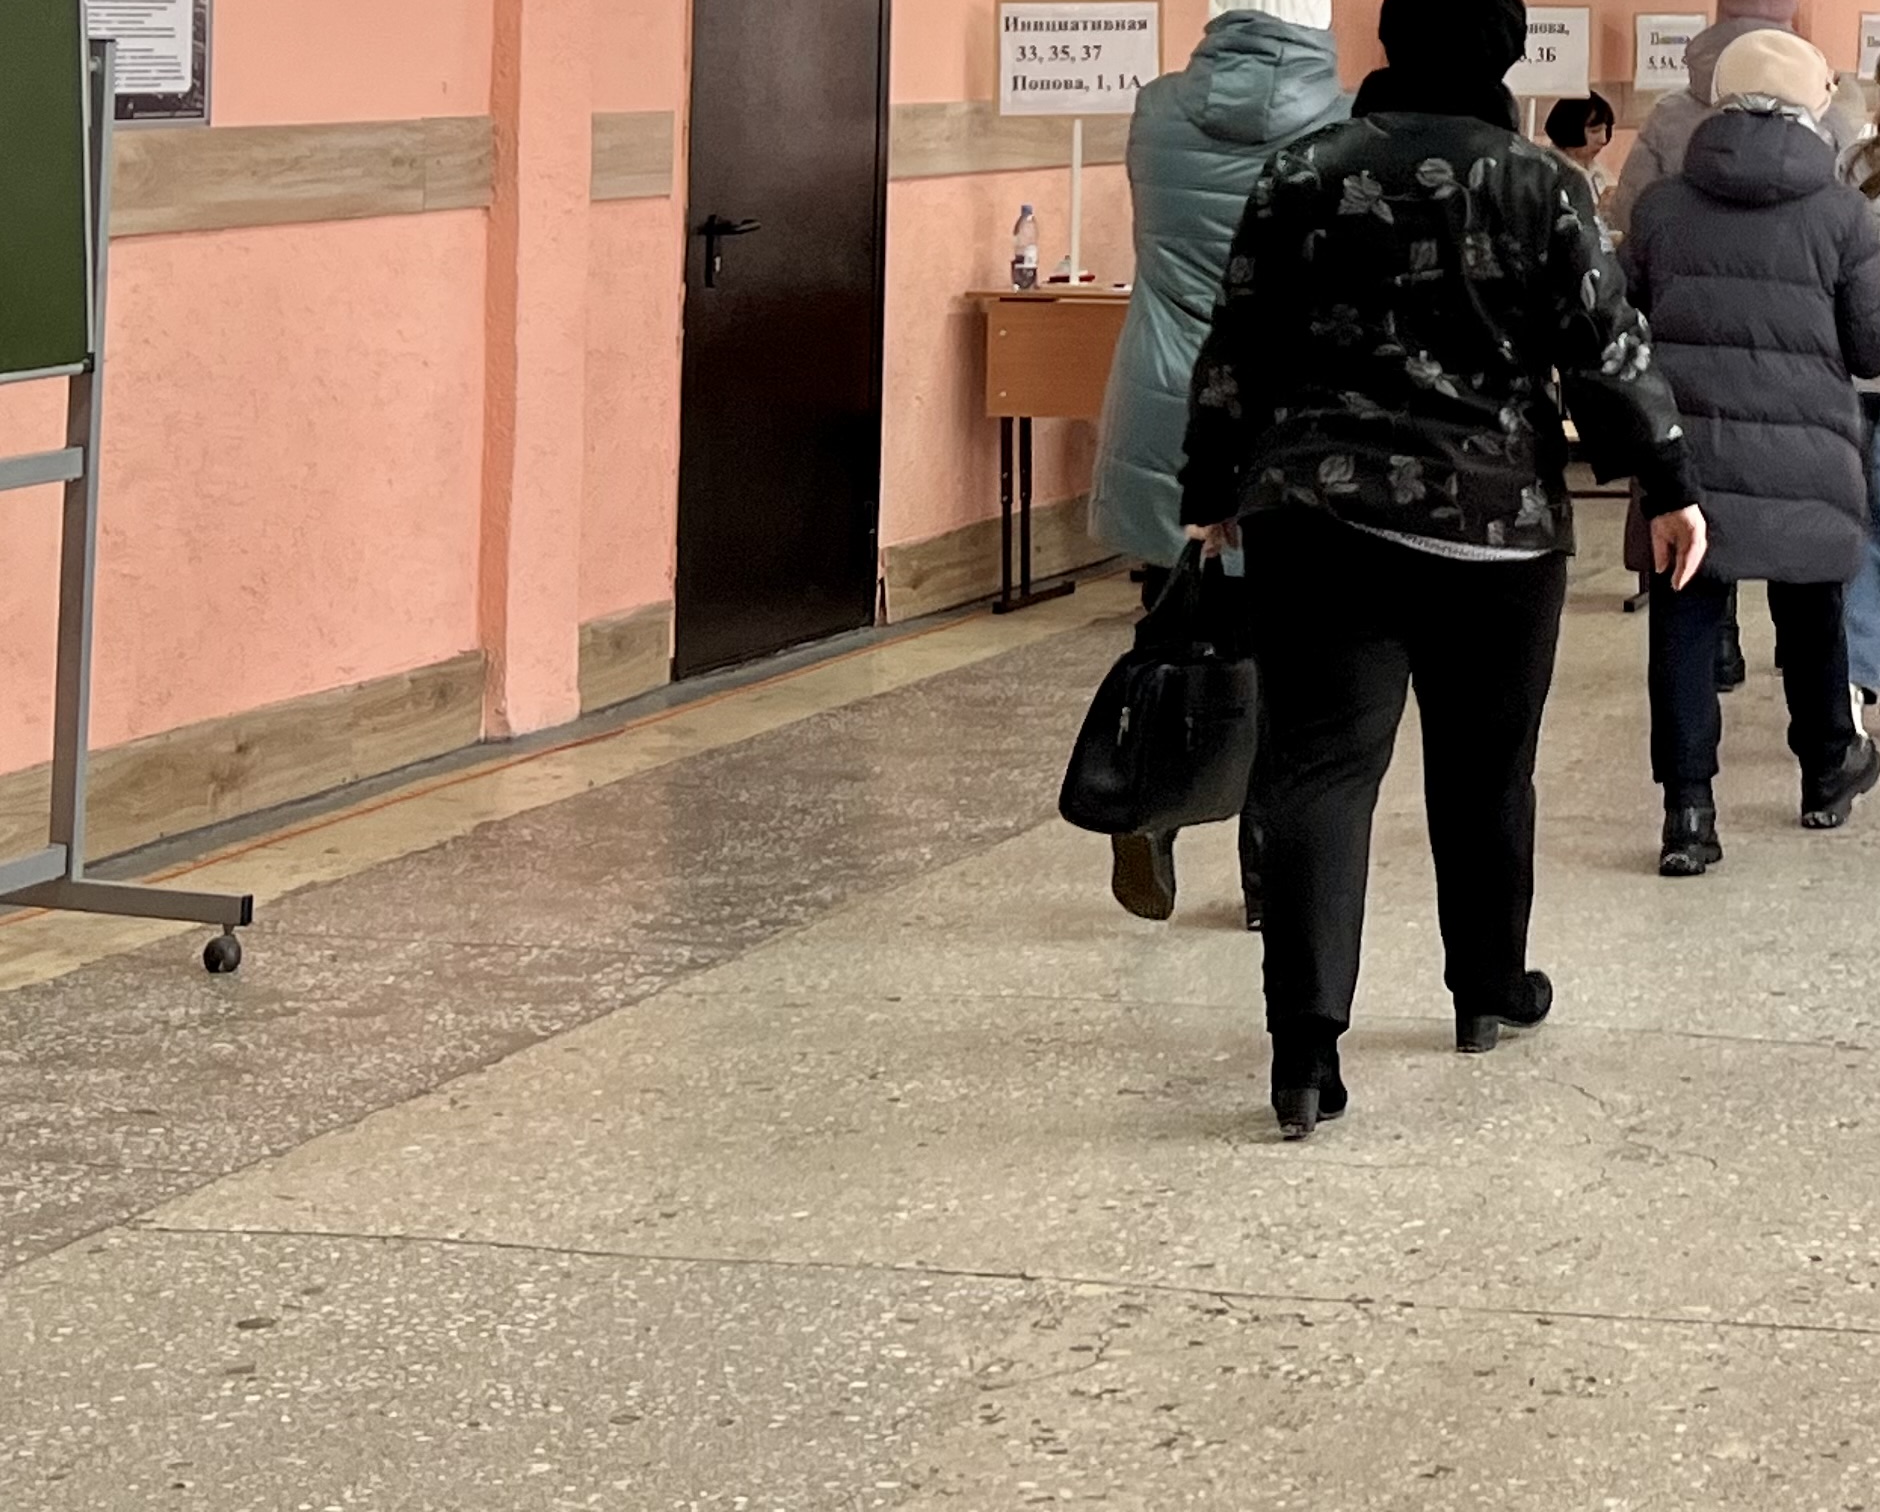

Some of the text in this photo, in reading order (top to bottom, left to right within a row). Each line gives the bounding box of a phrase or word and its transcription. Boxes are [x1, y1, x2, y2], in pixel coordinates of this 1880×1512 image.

[1004, 15, 1148, 32] Инициативная
[1016, 44, 1102, 64] 33, 35, 37
[1012, 73, 1142, 93] Попова, 1, 1А
